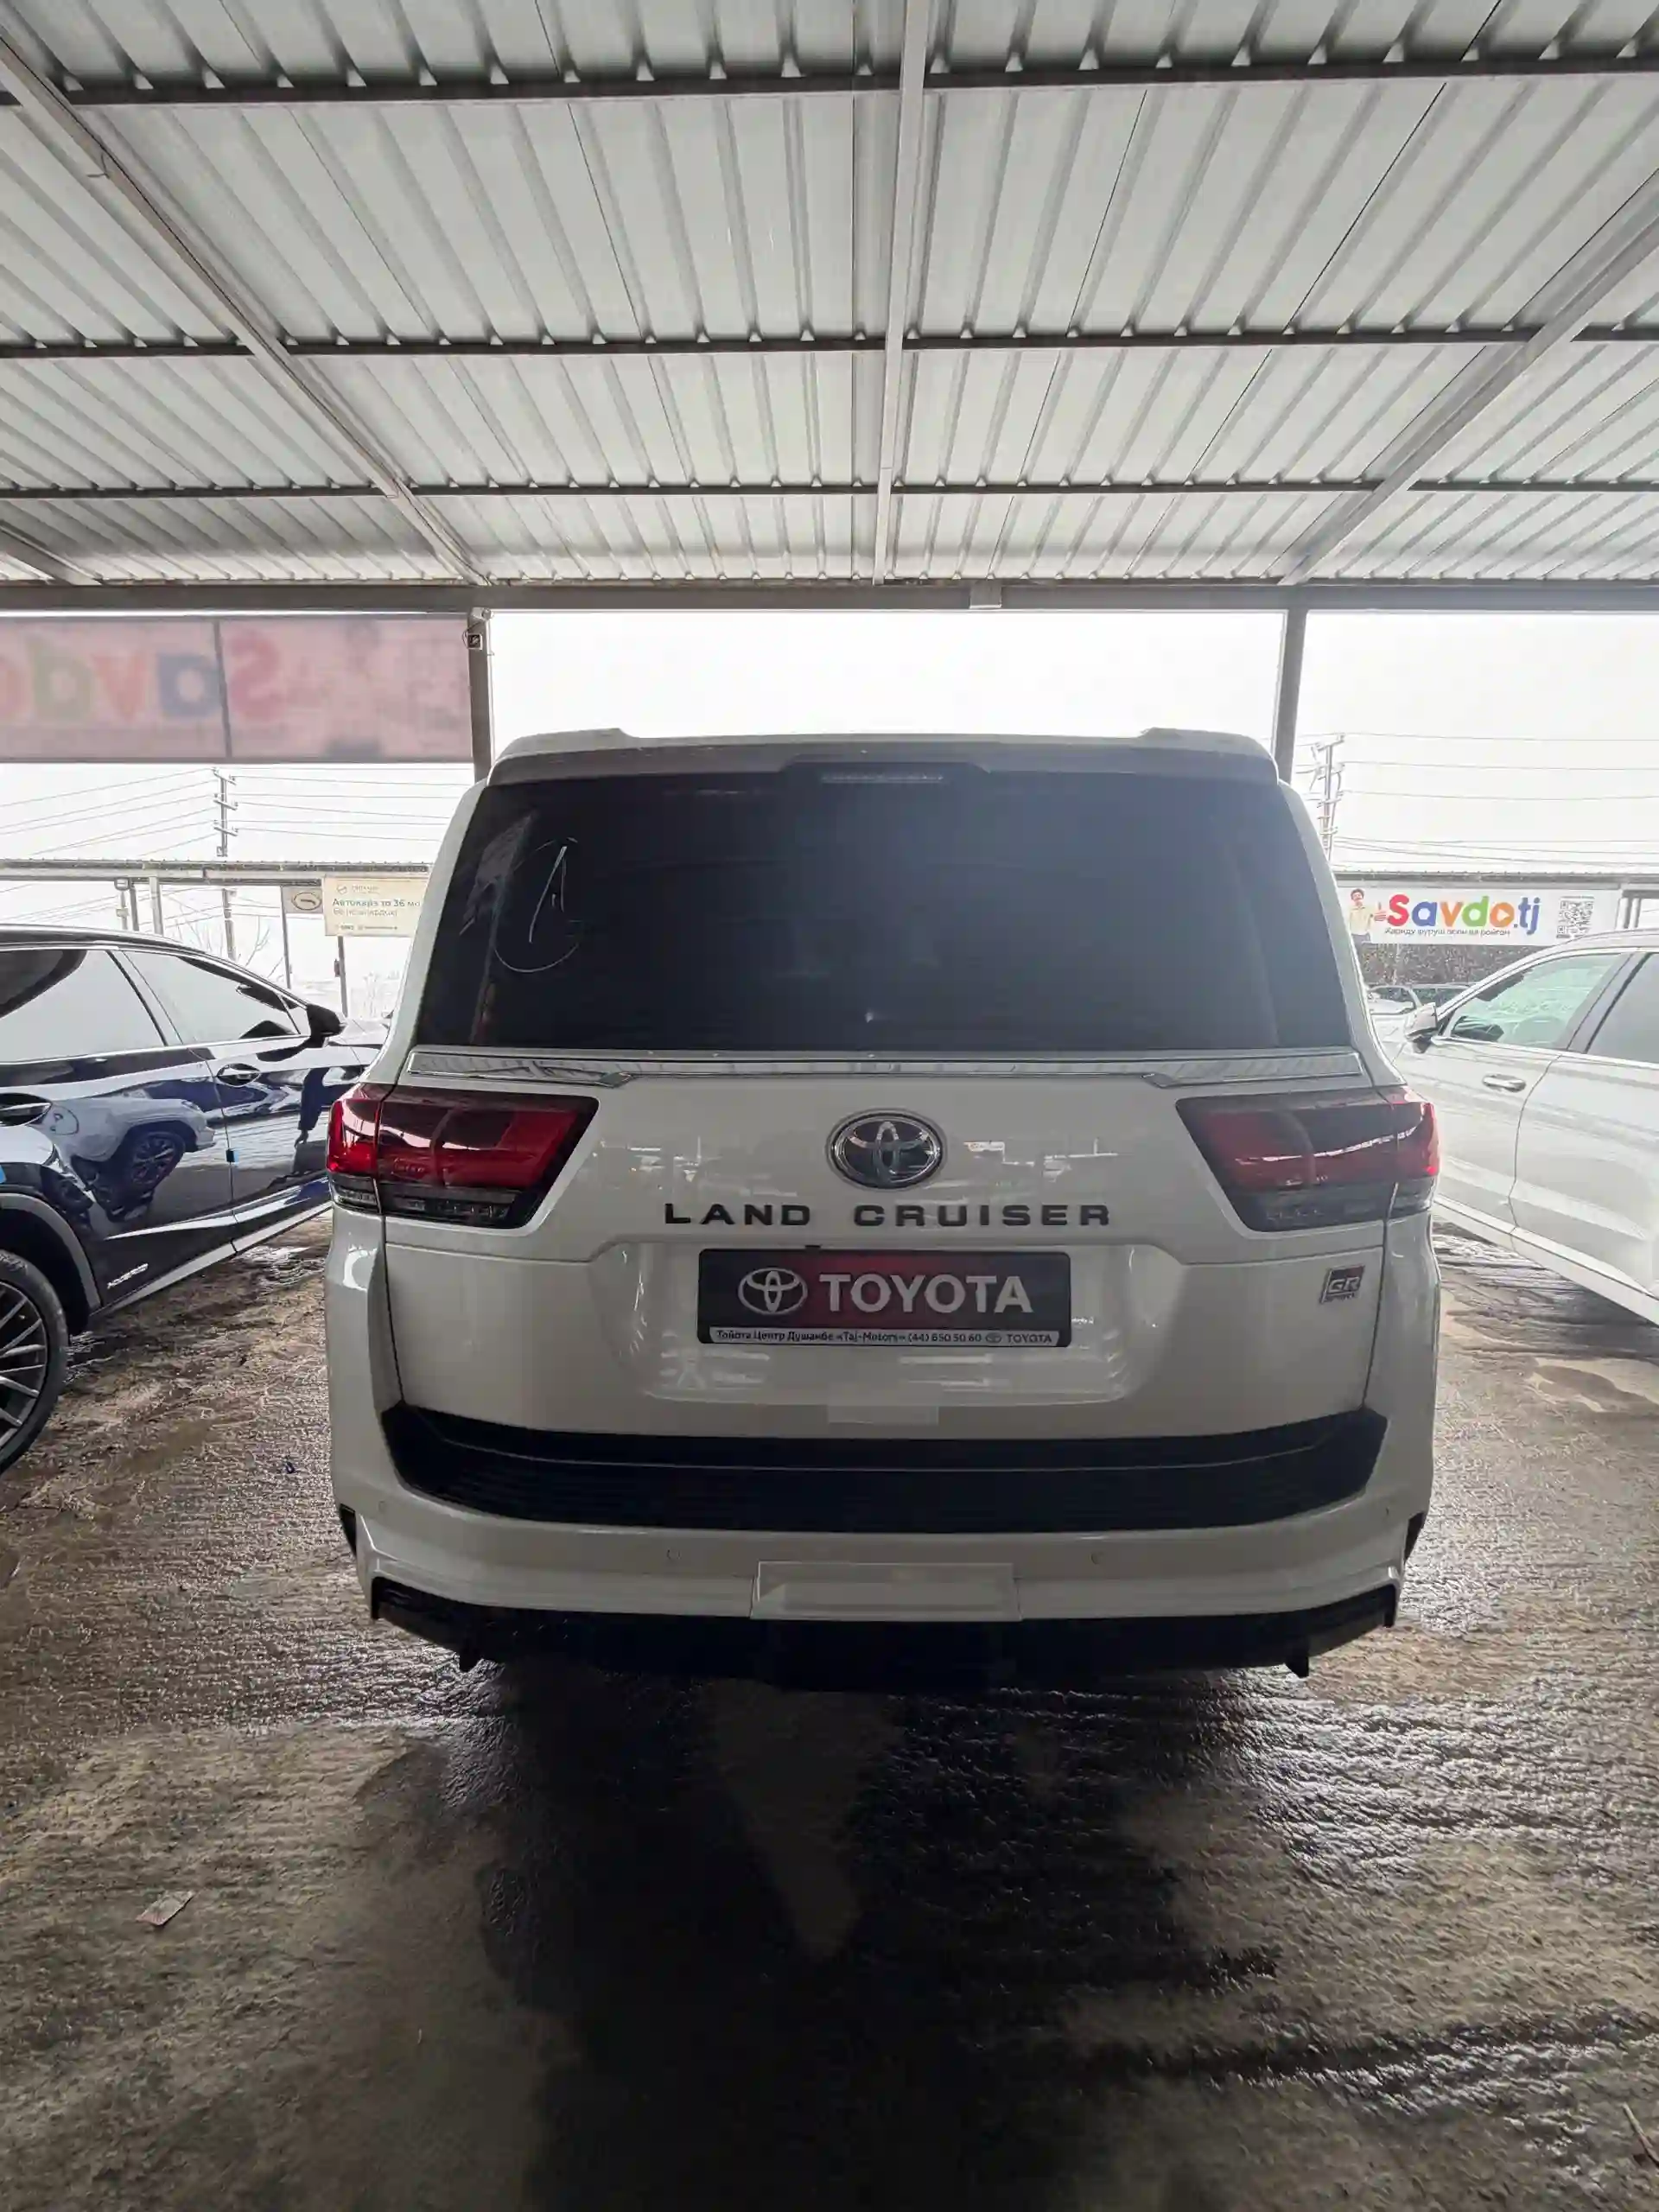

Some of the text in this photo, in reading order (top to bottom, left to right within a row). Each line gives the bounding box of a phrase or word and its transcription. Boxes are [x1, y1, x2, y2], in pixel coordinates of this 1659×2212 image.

[393, 899, 405, 907] 36
[1387, 893, 1541, 935] Savdo.tj
[664, 1203, 1110, 1227] LAND CRUISER
[818, 1273, 1033, 1313] TOYOTA
[716, 1329, 751, 1339] Тойота
[753, 1330, 785, 1342] Центр
[787, 1330, 833, 1342] Душанбе
[908, 1332, 929, 1344] (44)
[953, 1333, 966, 1343] 50
[1007, 1333, 1052, 1344] TOYOTA
